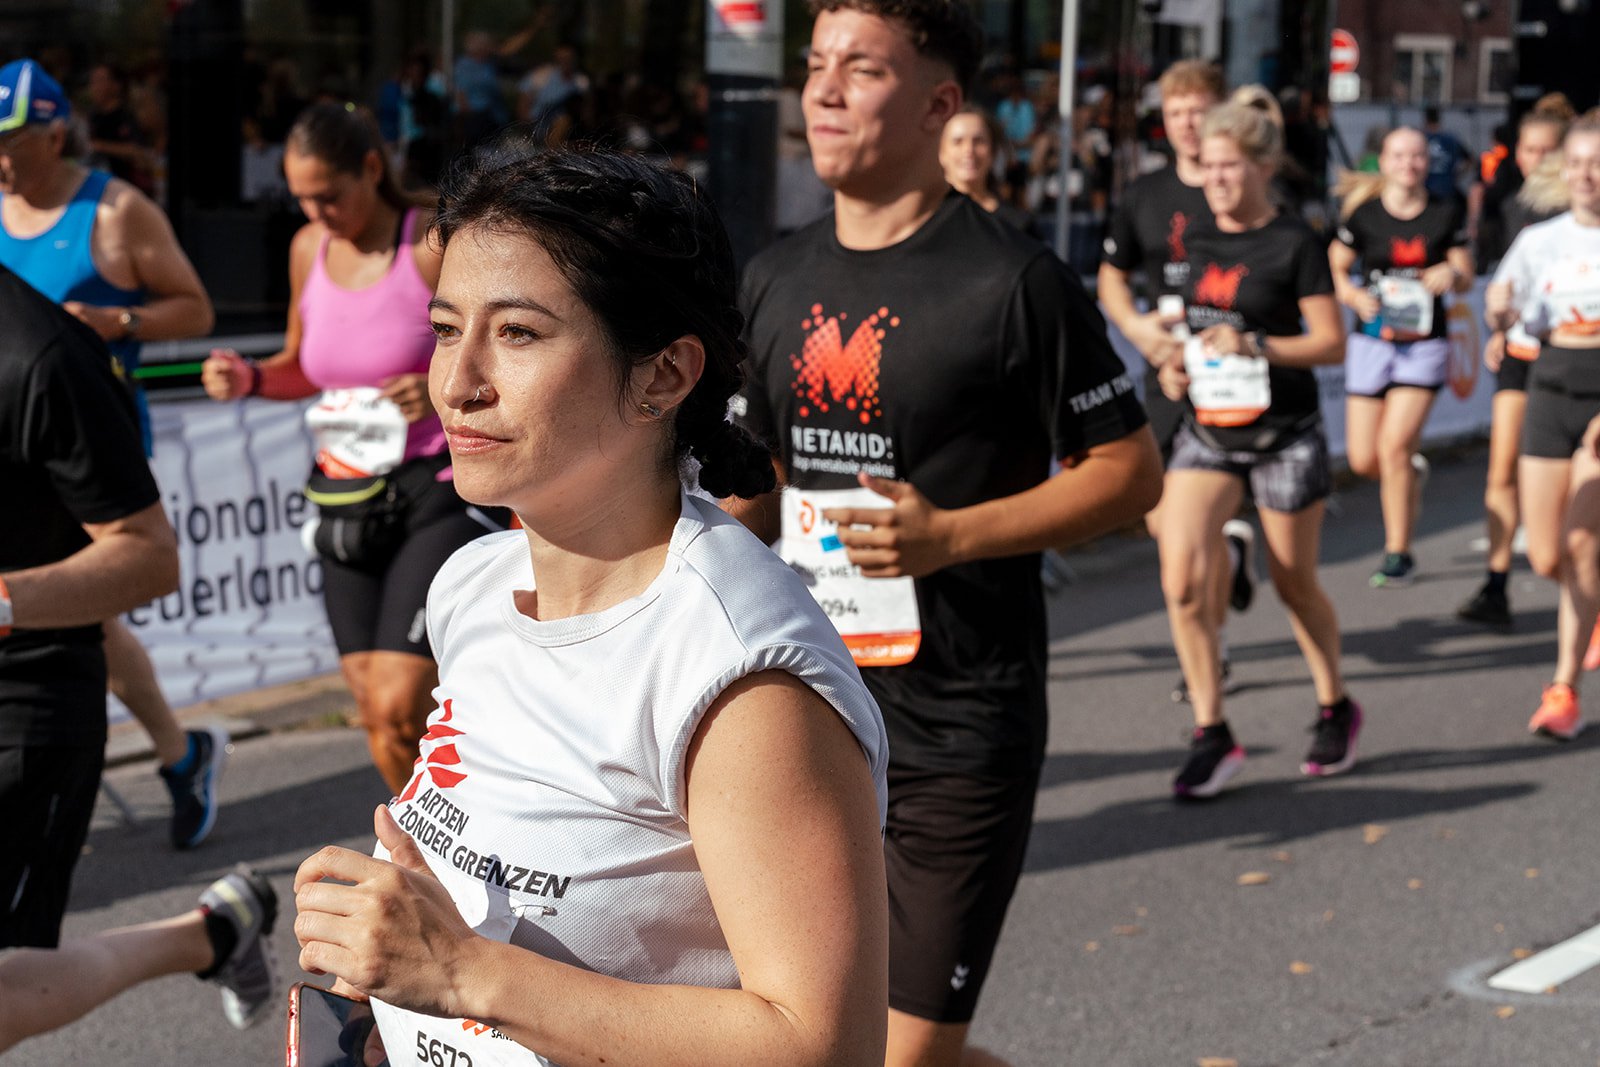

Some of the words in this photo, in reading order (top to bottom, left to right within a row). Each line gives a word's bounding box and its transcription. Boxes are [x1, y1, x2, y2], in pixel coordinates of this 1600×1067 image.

[1069, 382, 1114, 414] TEAM
[416, 787, 470, 837] ARTSEN
[398, 804, 453, 860] ZONDER
[452, 845, 572, 899] GRENZEN
